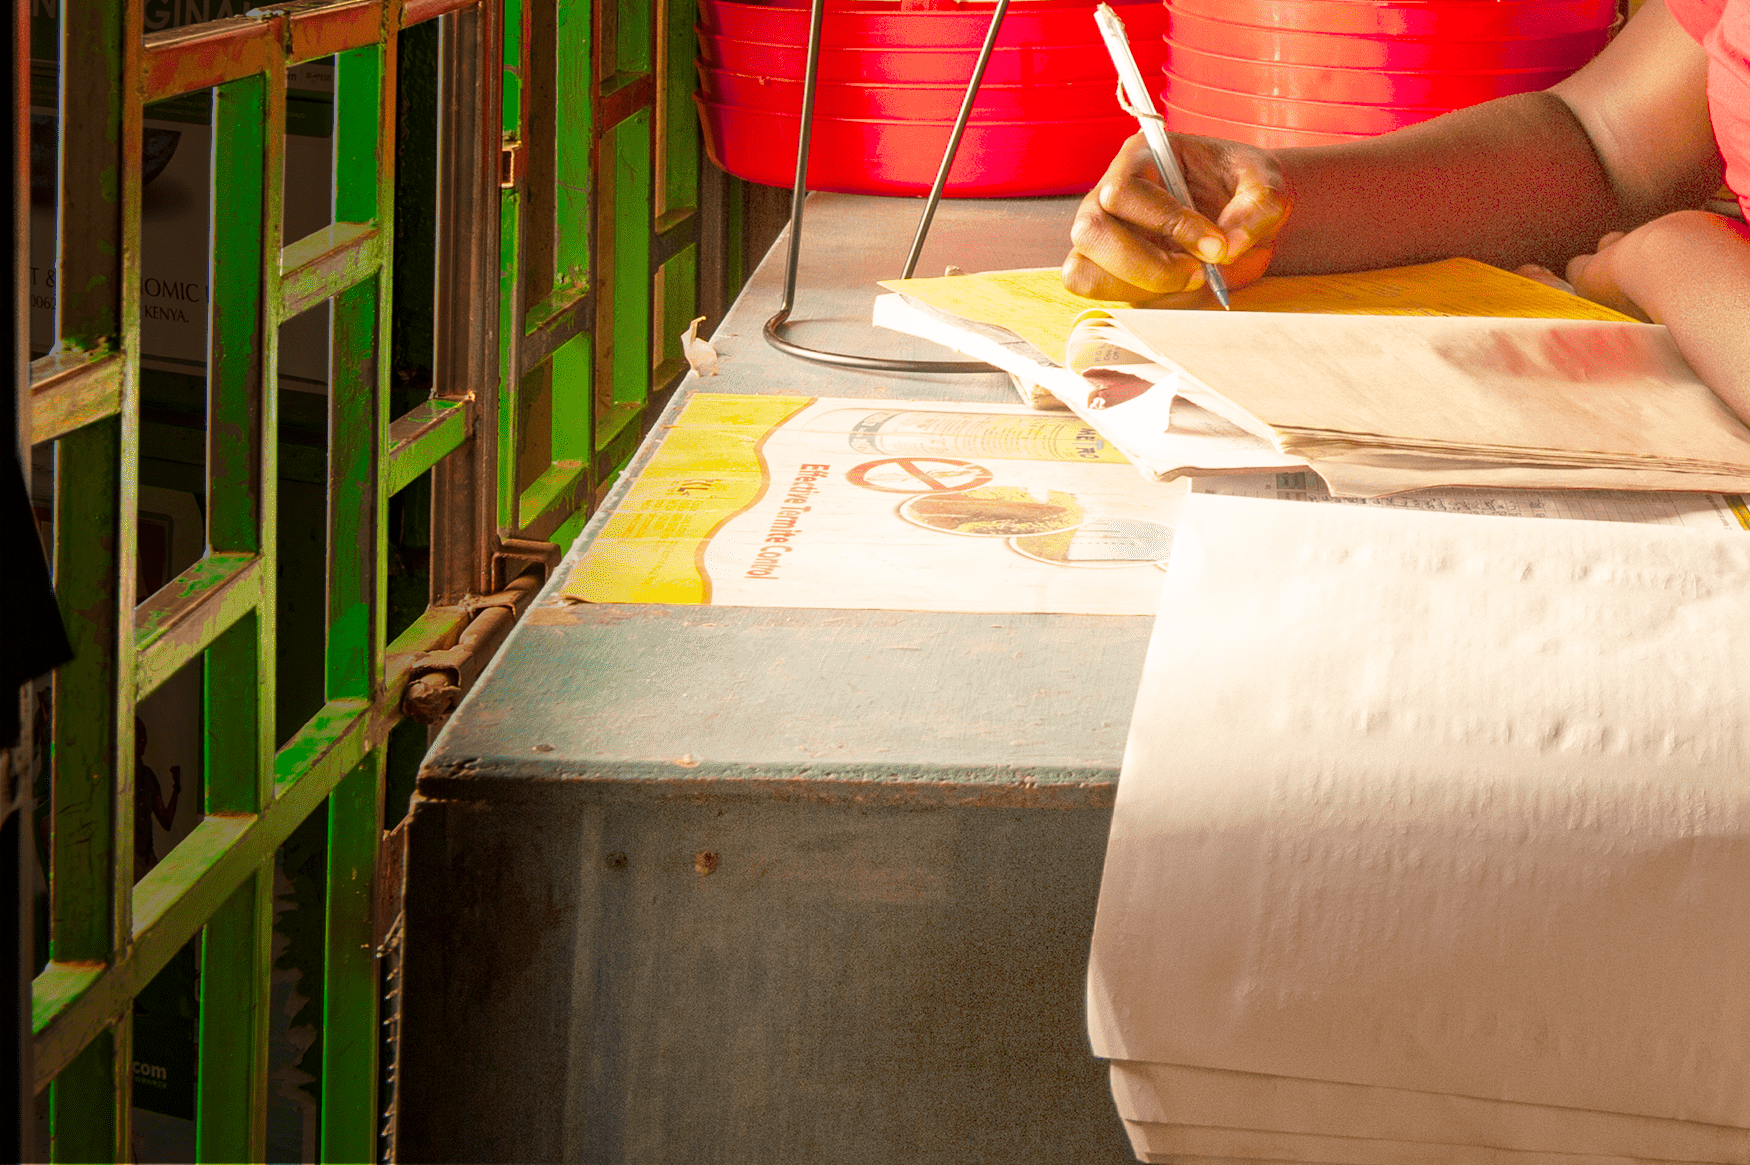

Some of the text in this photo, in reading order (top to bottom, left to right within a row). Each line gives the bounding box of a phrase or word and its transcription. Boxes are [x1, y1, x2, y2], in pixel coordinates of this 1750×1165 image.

[145, 305, 190, 324] KENYA.
[743, 463, 831, 580] Effective Termite Control
